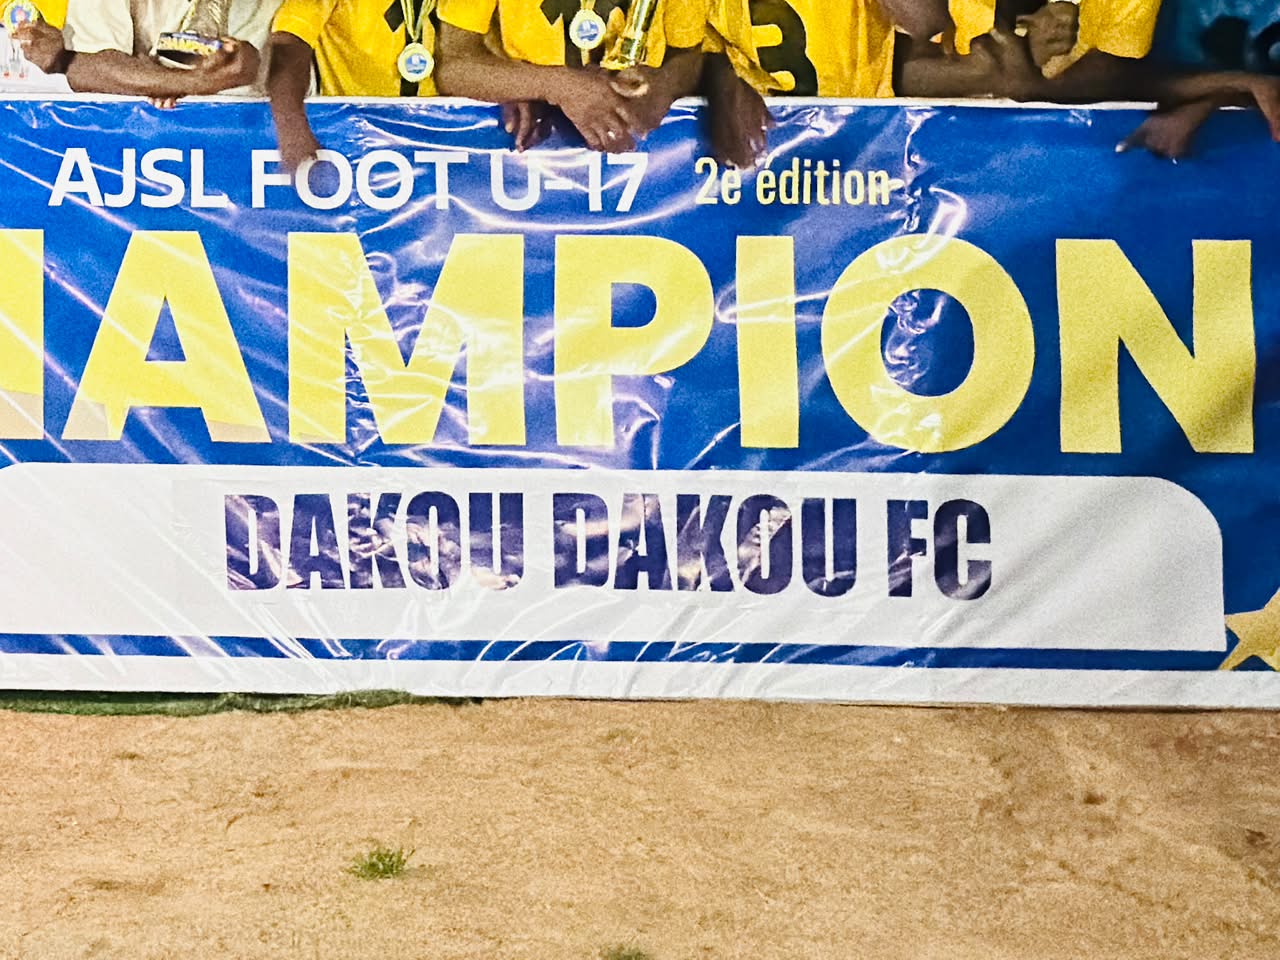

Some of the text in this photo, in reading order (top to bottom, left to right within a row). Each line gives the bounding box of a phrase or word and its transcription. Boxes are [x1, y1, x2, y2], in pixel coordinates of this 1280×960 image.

[47, 147, 649, 213] AJSL FOOT U-17
[694, 156, 890, 206] 2e édition
[224, 490, 993, 601] DAKOU DAKOU FC
